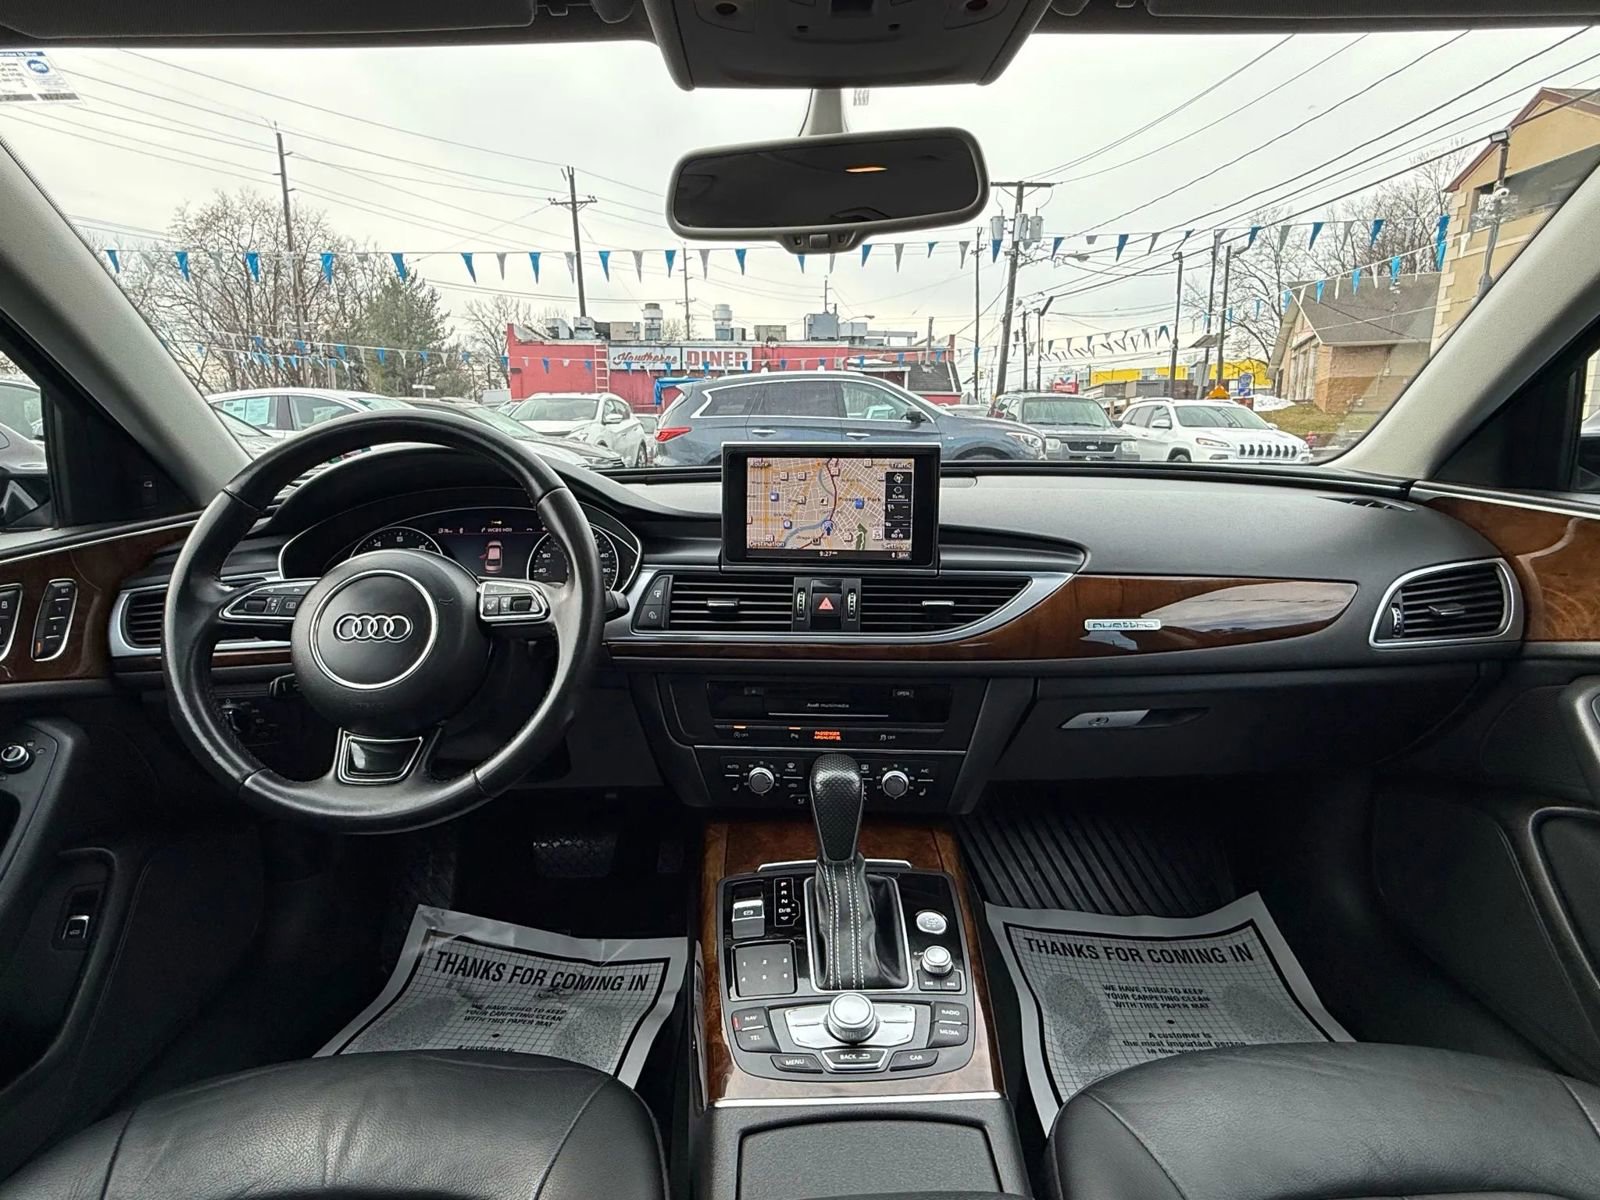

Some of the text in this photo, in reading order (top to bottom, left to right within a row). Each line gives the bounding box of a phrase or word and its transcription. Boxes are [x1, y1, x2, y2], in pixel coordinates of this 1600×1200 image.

[687, 351, 748, 367] DINER
[749, 540, 785, 549] Destination
[1024, 937, 1255, 964] THANKS FOR COMING IN
[434, 951, 650, 992] THANKS FOR COMING IN
[1104, 992, 1130, 1000] YOUR
[1131, 993, 1180, 1001] CARPETING
[939, 1028, 960, 1036] MEDIA
[1166, 1040, 1213, 1048] important
